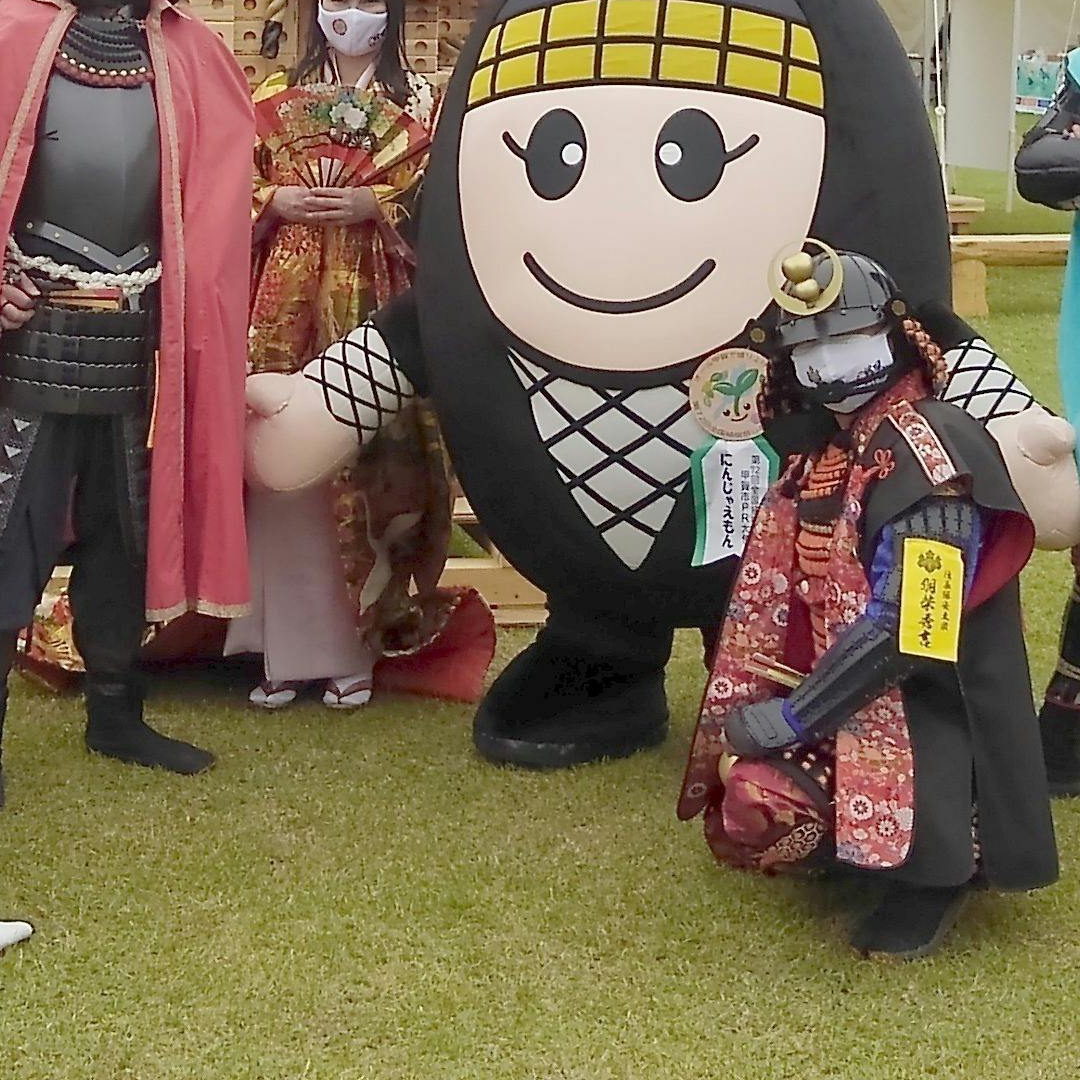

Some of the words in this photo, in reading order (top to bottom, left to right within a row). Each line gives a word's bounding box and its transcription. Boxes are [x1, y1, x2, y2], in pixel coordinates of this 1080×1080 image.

[720, 453, 735, 549] にんじゃえもん
